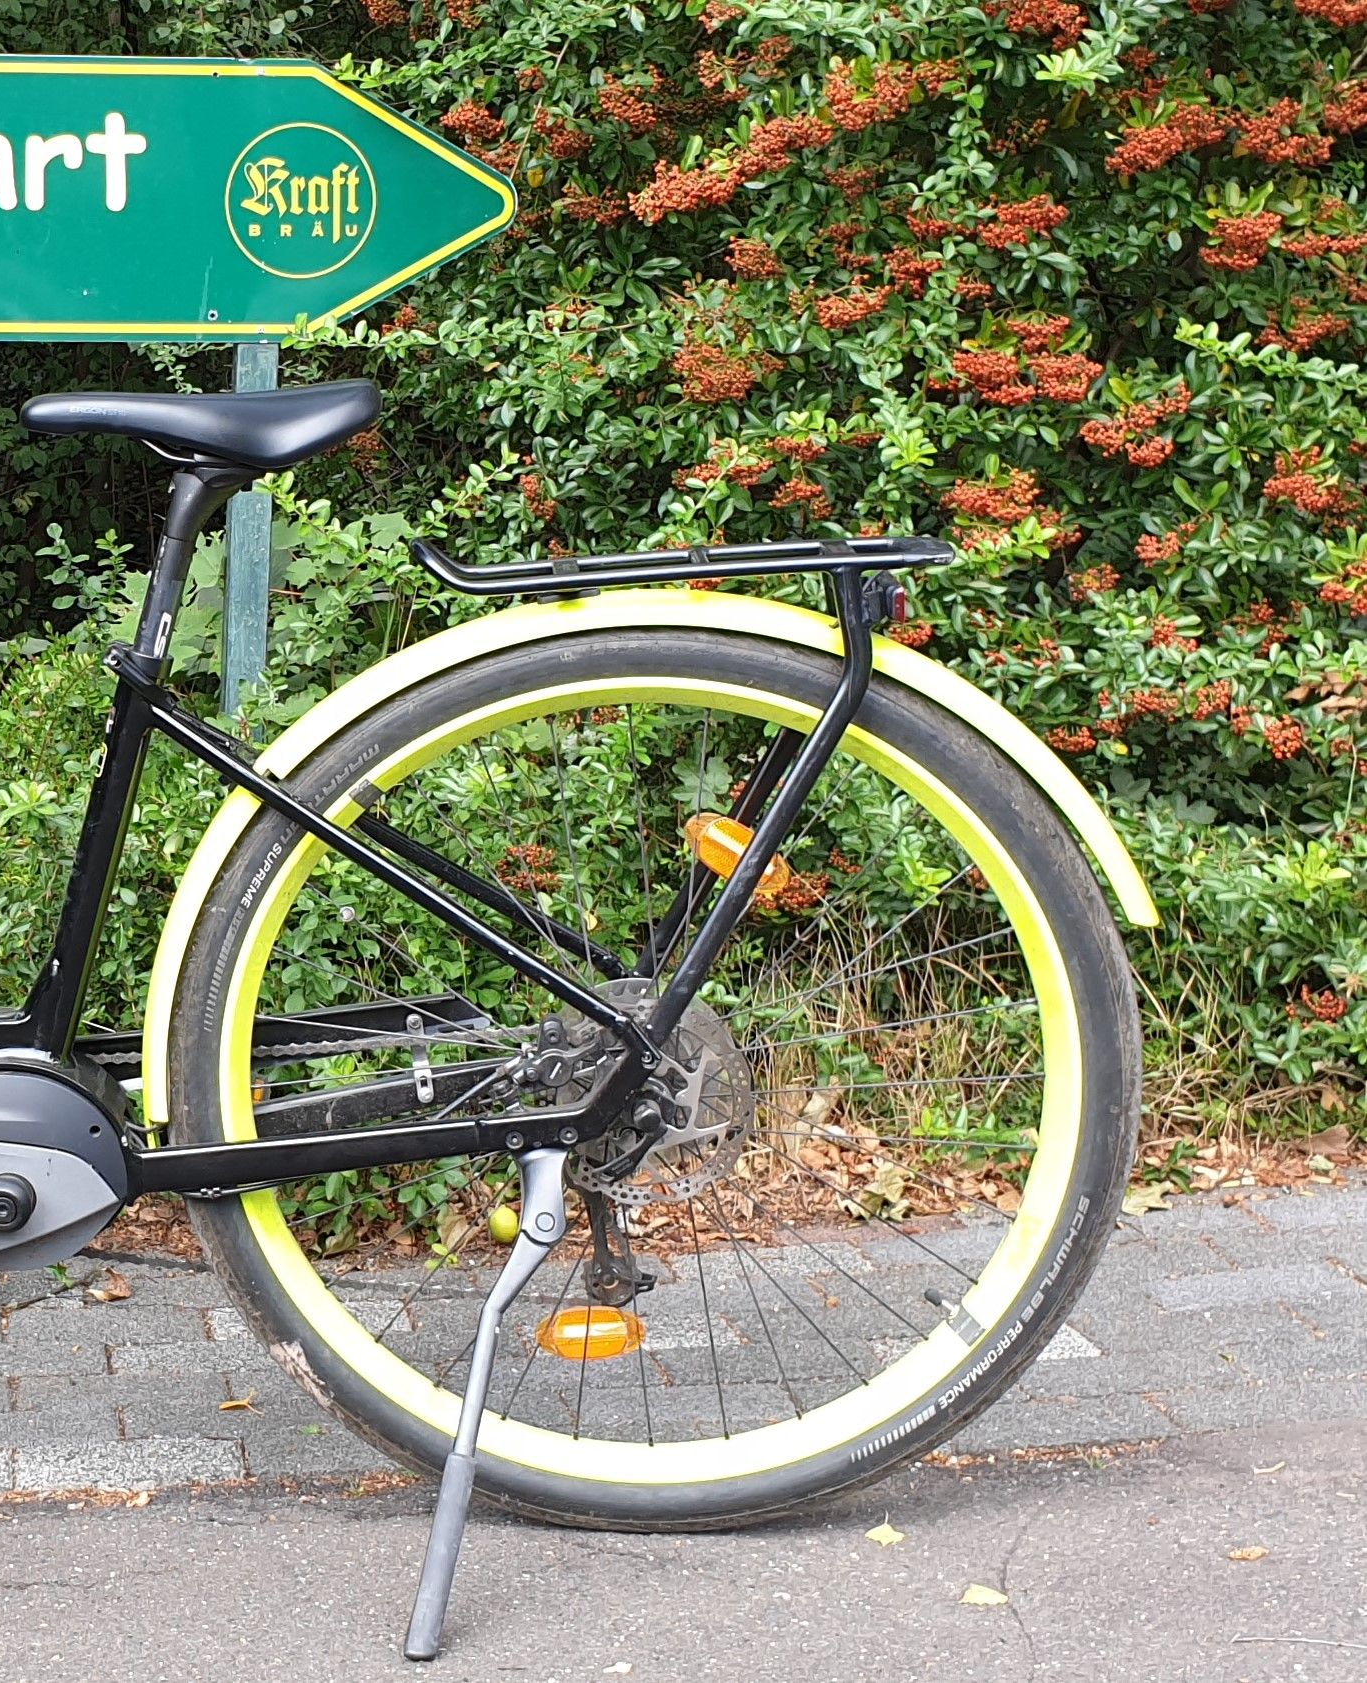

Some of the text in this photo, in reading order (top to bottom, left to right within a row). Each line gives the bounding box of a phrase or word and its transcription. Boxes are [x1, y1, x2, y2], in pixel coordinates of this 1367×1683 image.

[240, 157, 361, 244] Kraft
[248, 220, 358, 237] BRÄU
[241, 743, 381, 910] MARATN SUPREME
[938, 1194, 1091, 1410] SCHWALBE PERFORMANCE
